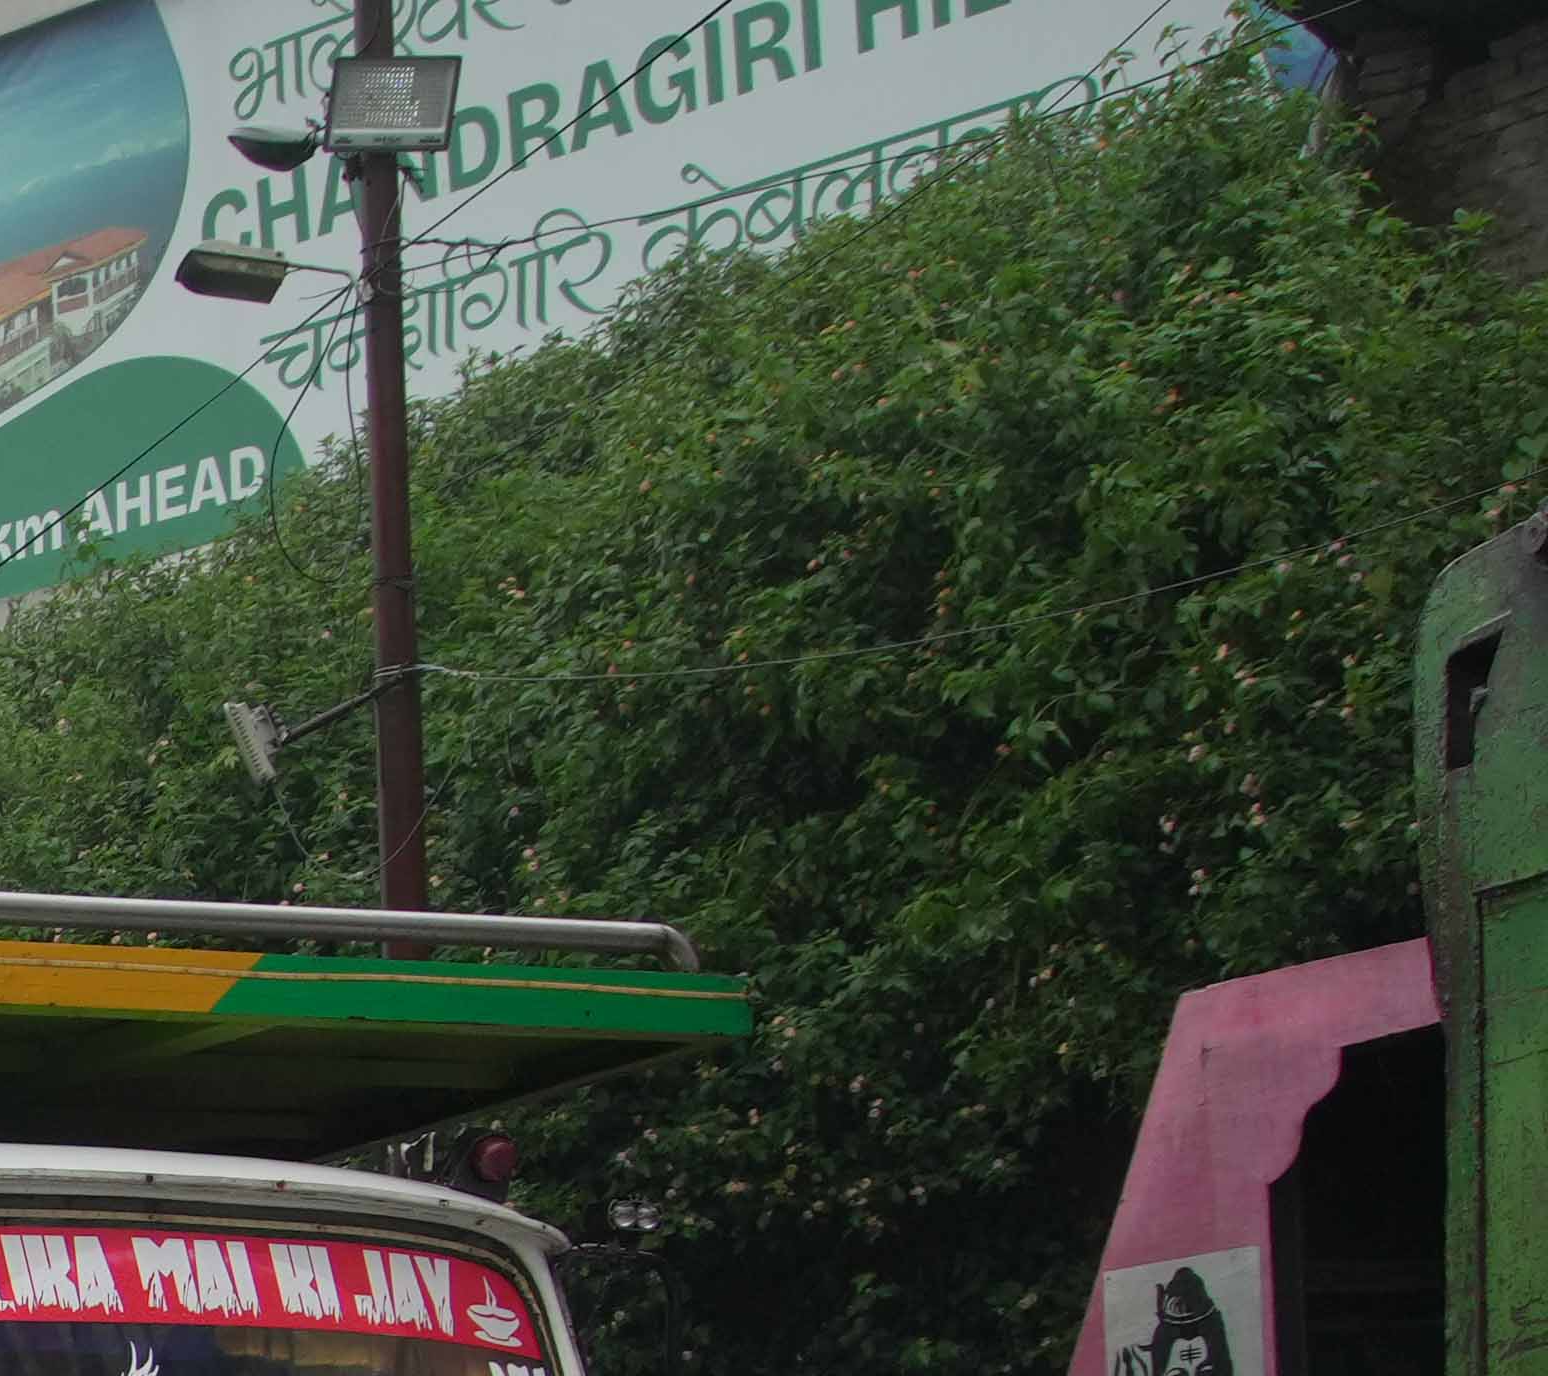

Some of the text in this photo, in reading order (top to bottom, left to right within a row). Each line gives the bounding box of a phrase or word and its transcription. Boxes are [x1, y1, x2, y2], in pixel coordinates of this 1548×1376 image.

[78, 446, 266, 539] AHEAD
[131, 1236, 261, 1319] MAI
[269, 1242, 343, 1323] KI
[354, 1249, 455, 1337] JAY
